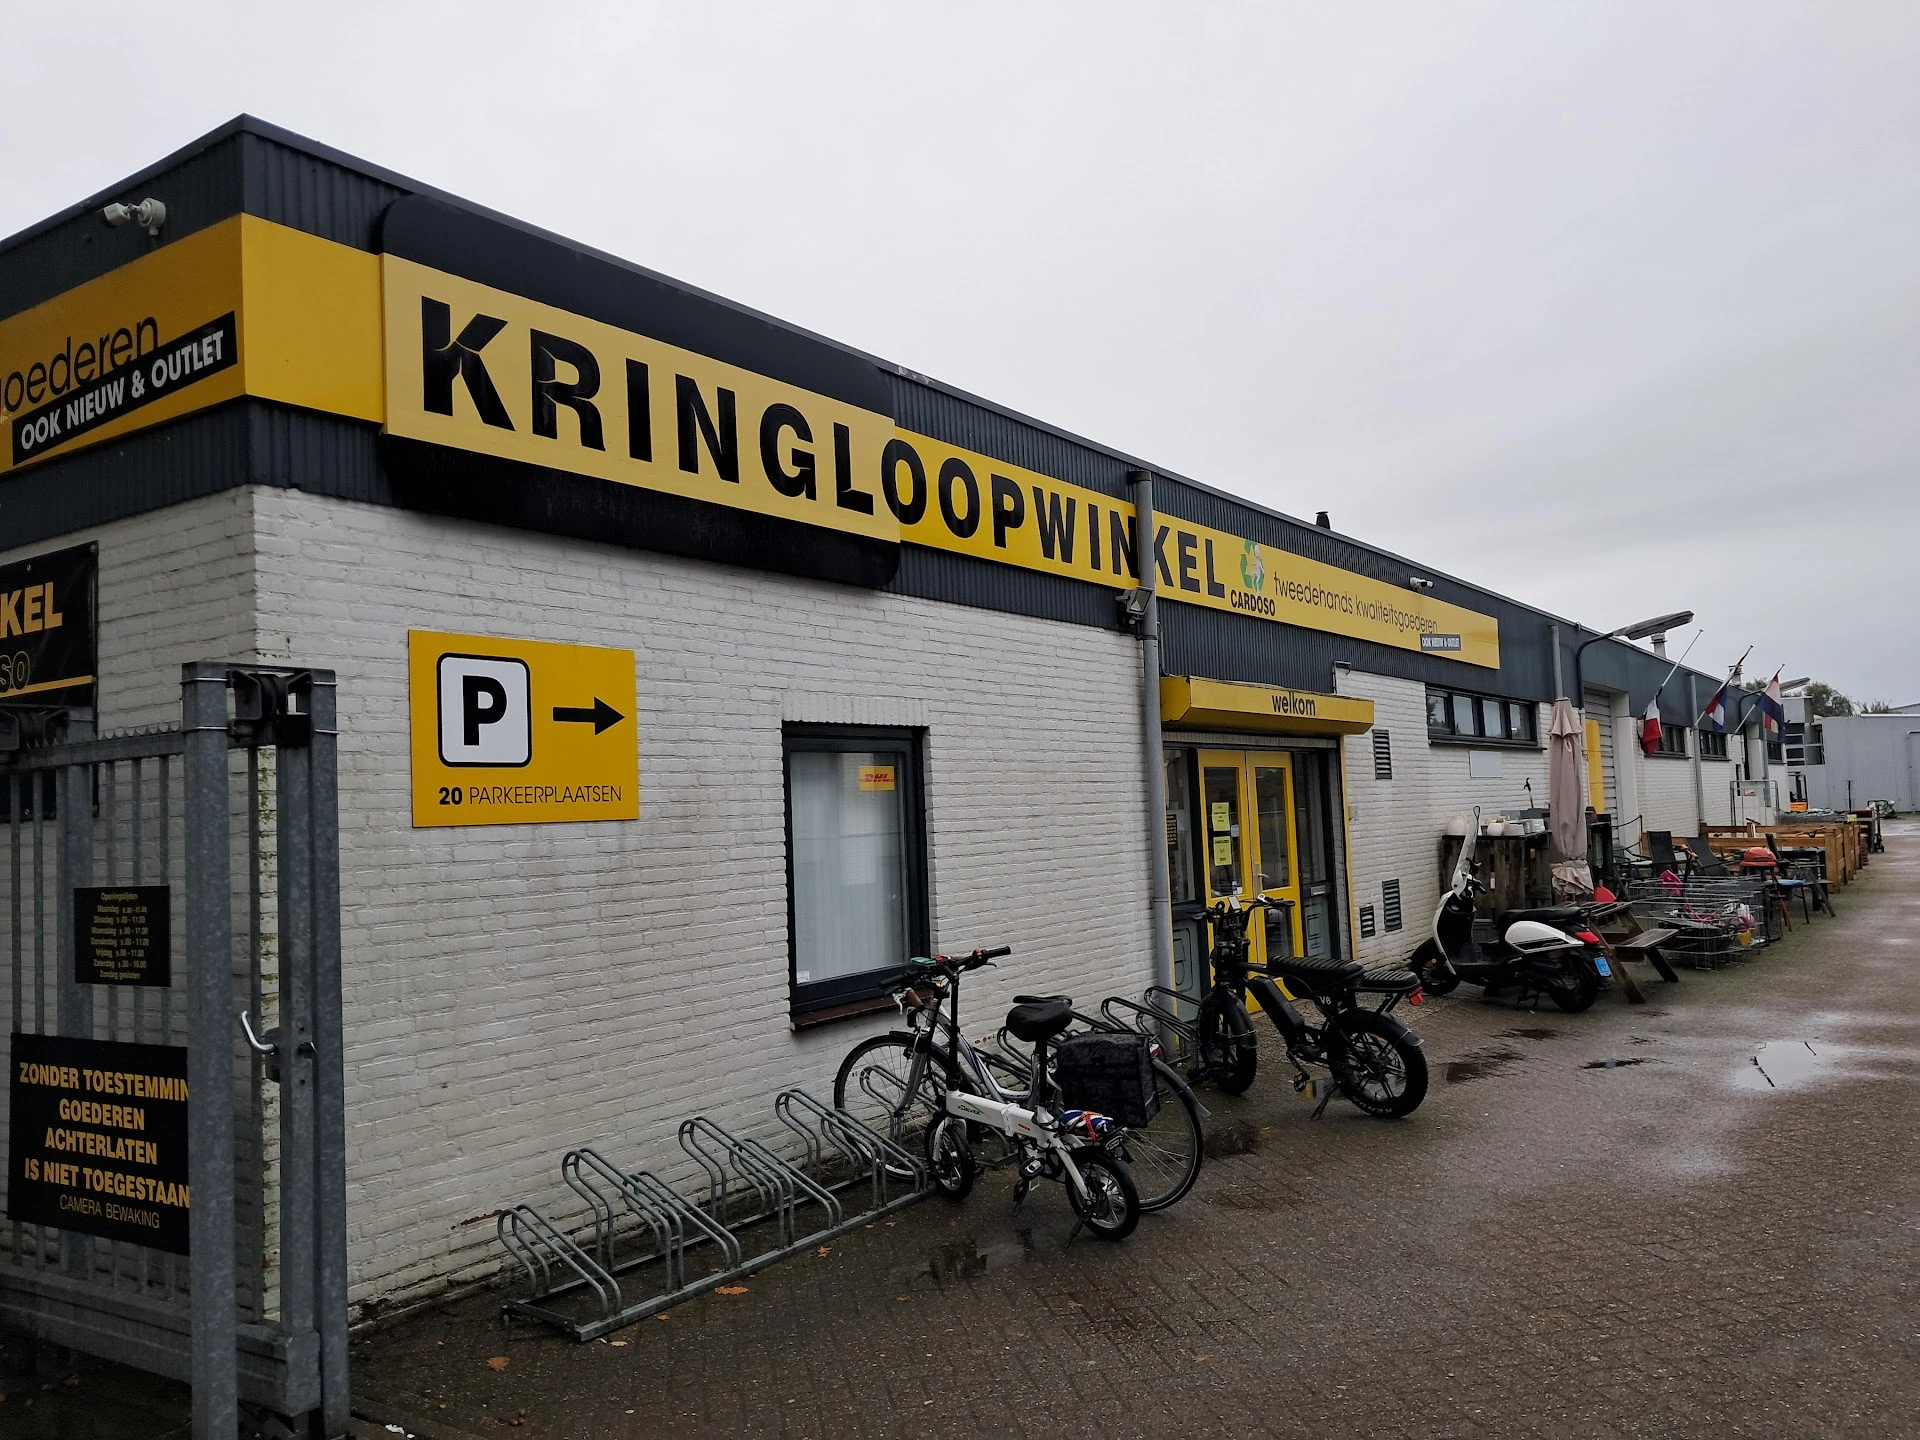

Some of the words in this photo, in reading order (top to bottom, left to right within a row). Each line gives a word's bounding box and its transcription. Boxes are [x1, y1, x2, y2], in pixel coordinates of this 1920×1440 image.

[0, 316, 158, 412] oederen
[21, 408, 61, 450] OOK
[66, 377, 124, 429] NIEUW
[131, 370, 145, 398] &
[152, 330, 224, 388] OUTLET
[1230, 589, 1276, 617] CARDOSO
[1274, 571, 1354, 615] tweedehands
[1356, 597, 1438, 635] kwaliteitsgoederen
[462, 674, 508, 746] P
[1272, 692, 1316, 716] welkom
[439, 786, 463, 806] 20
[469, 786, 622, 805] PARKEERPLAATSEN
[1318, 996, 1332, 1005] V8
[19, 1062, 79, 1090] ZONDER
[59, 1098, 145, 1130] GOEDEREN
[45, 1127, 158, 1165] ACHTERLATEN
[24, 1158, 39, 1181] IS
[44, 1161, 79, 1187] NIET
[83, 1167, 190, 1208] TOEGESTAAN
[59, 1194, 102, 1217] CAMERA
[106, 1202, 160, 1229] BEWAKING
